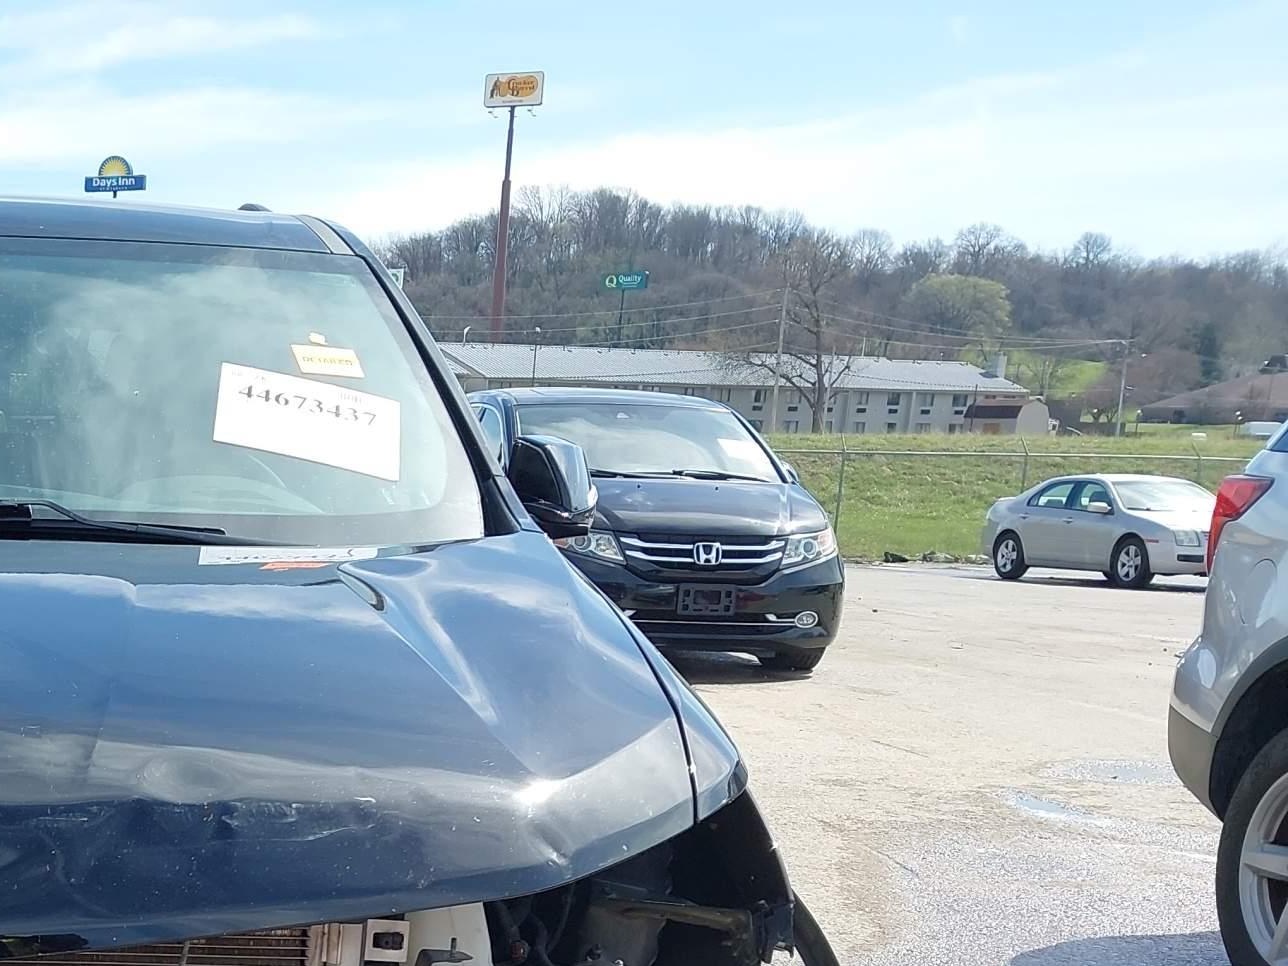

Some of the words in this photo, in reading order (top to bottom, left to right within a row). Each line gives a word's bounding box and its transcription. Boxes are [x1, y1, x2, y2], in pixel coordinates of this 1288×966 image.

[92, 177, 117, 187] Days
[118, 176, 135, 186] Inn
[618, 274, 642, 285] Quality
[238, 384, 377, 426] 44673437
